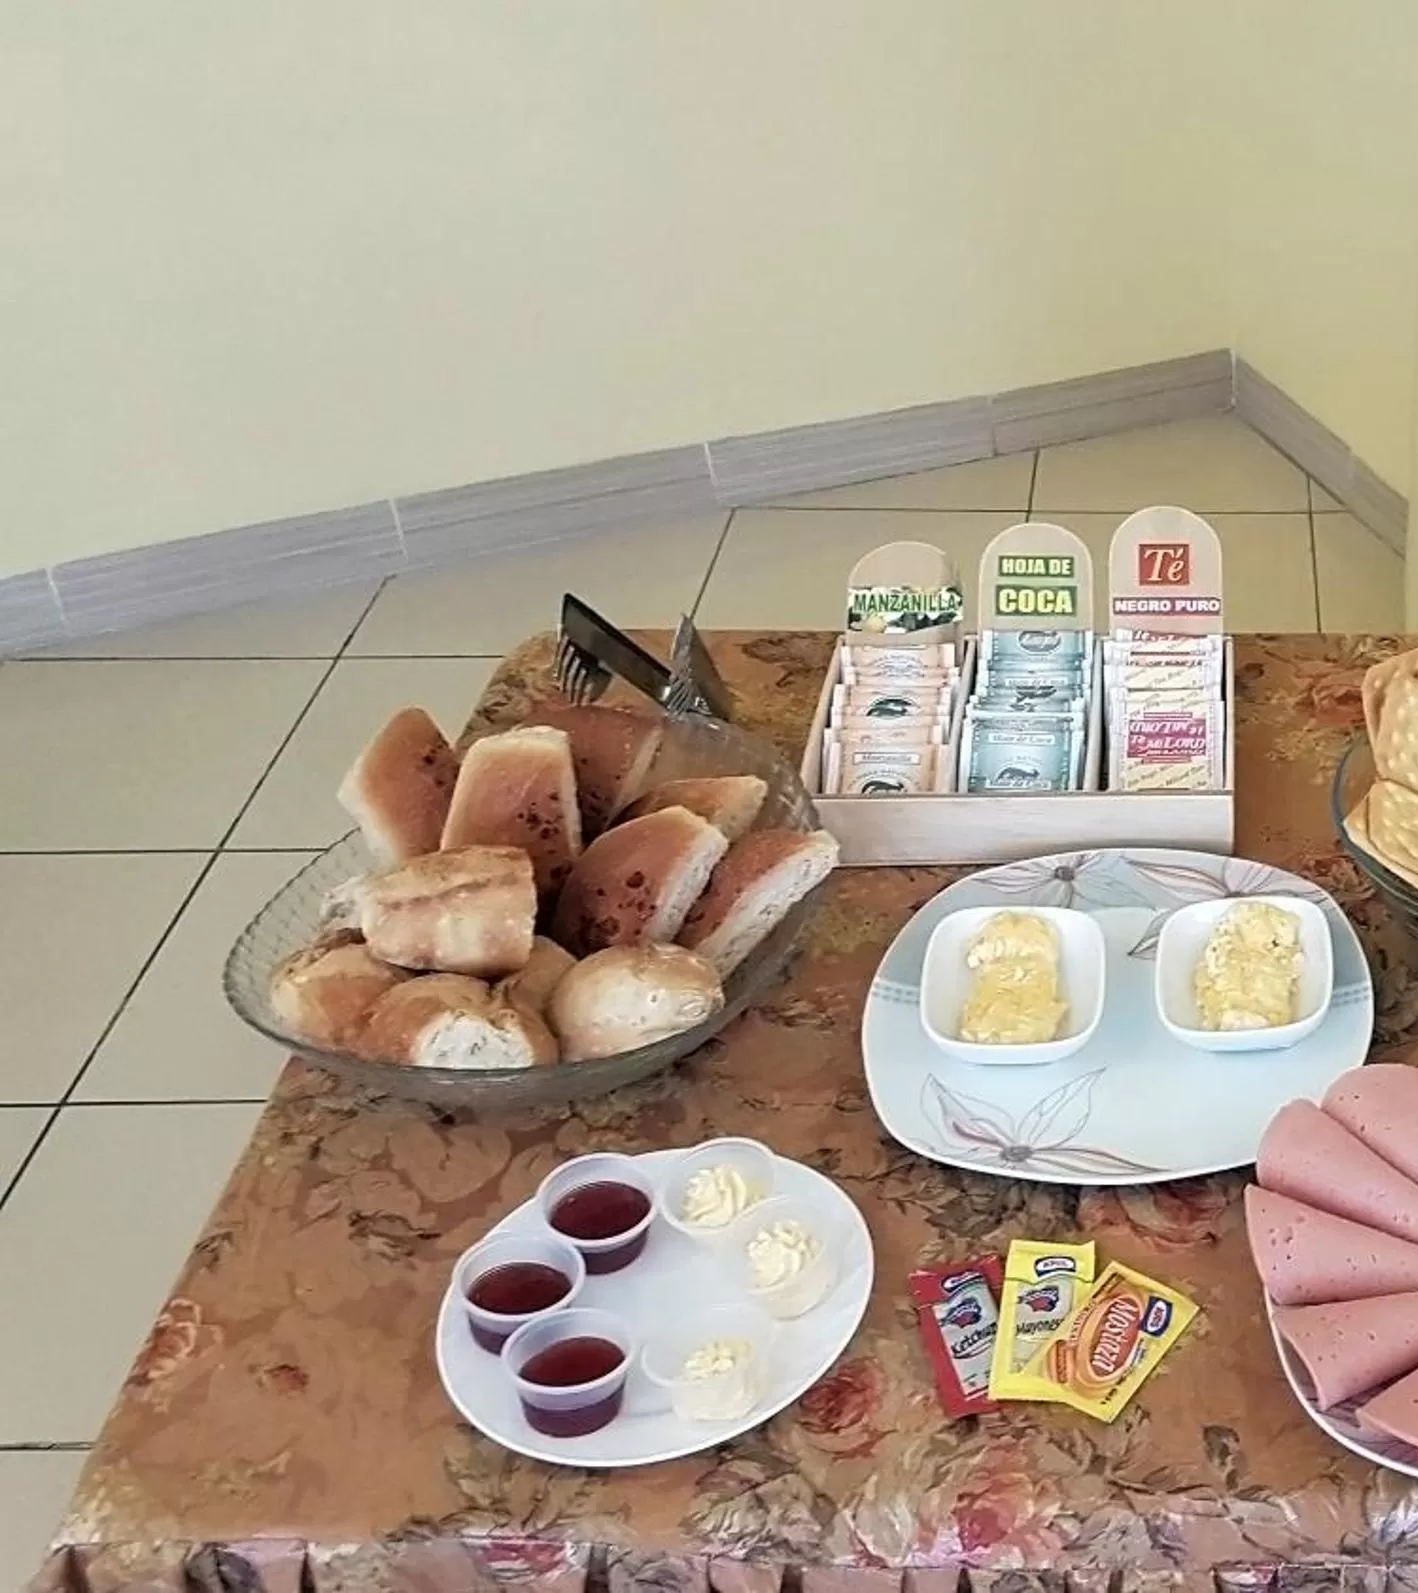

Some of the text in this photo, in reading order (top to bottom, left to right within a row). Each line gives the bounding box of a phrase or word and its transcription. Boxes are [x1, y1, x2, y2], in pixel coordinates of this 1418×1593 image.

[1002, 558, 1071, 575] HOJA DE
[1143, 547, 1184, 582] Té
[853, 592, 957, 612] MANZANILLA
[998, 588, 1073, 614] COCA
[1114, 600, 1220, 613] NEGRO PURO
